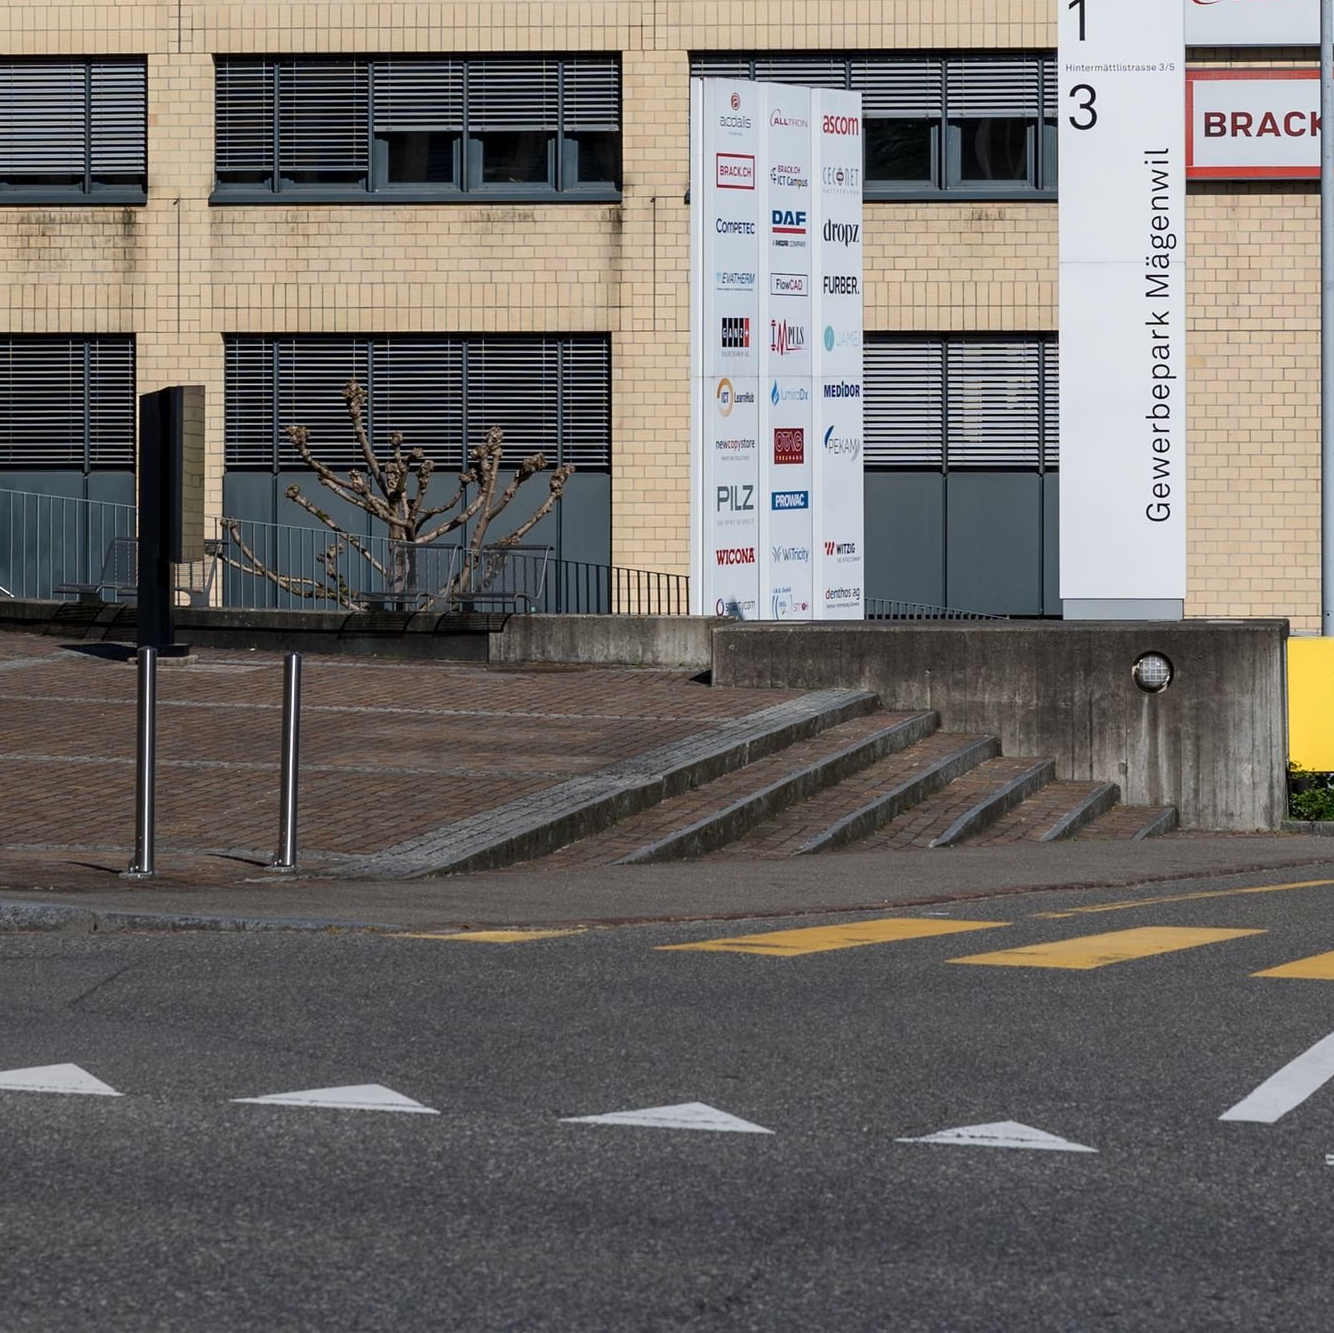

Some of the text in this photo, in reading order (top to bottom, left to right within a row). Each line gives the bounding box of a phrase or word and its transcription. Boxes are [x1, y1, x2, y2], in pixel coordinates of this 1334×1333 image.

[1065, 63, 1176, 73] Hintermättlistrasse 3/5
[1069, 84, 1098, 131] 3
[823, 115, 859, 136] ascom
[720, 165, 752, 179] BRACK.CH
[778, 176, 809, 189] ICT Campus
[772, 210, 806, 226] DAF
[823, 218, 859, 247] dropz
[722, 272, 755, 284] EVATHERM
[776, 278, 803, 291] FlowCAD
[823, 276, 860, 294] FURBER.
[1145, 148, 1177, 523] Gewerbepark Mägenwil
[716, 438, 755, 451] newcopystore
[717, 485, 754, 512] PILZ
[775, 494, 805, 508] PROWAC
[782, 547, 809, 562] WiTricity
[836, 543, 855, 555] WITZIG
[716, 548, 755, 565] WICONA
[826, 587, 860, 600] denthos ag
